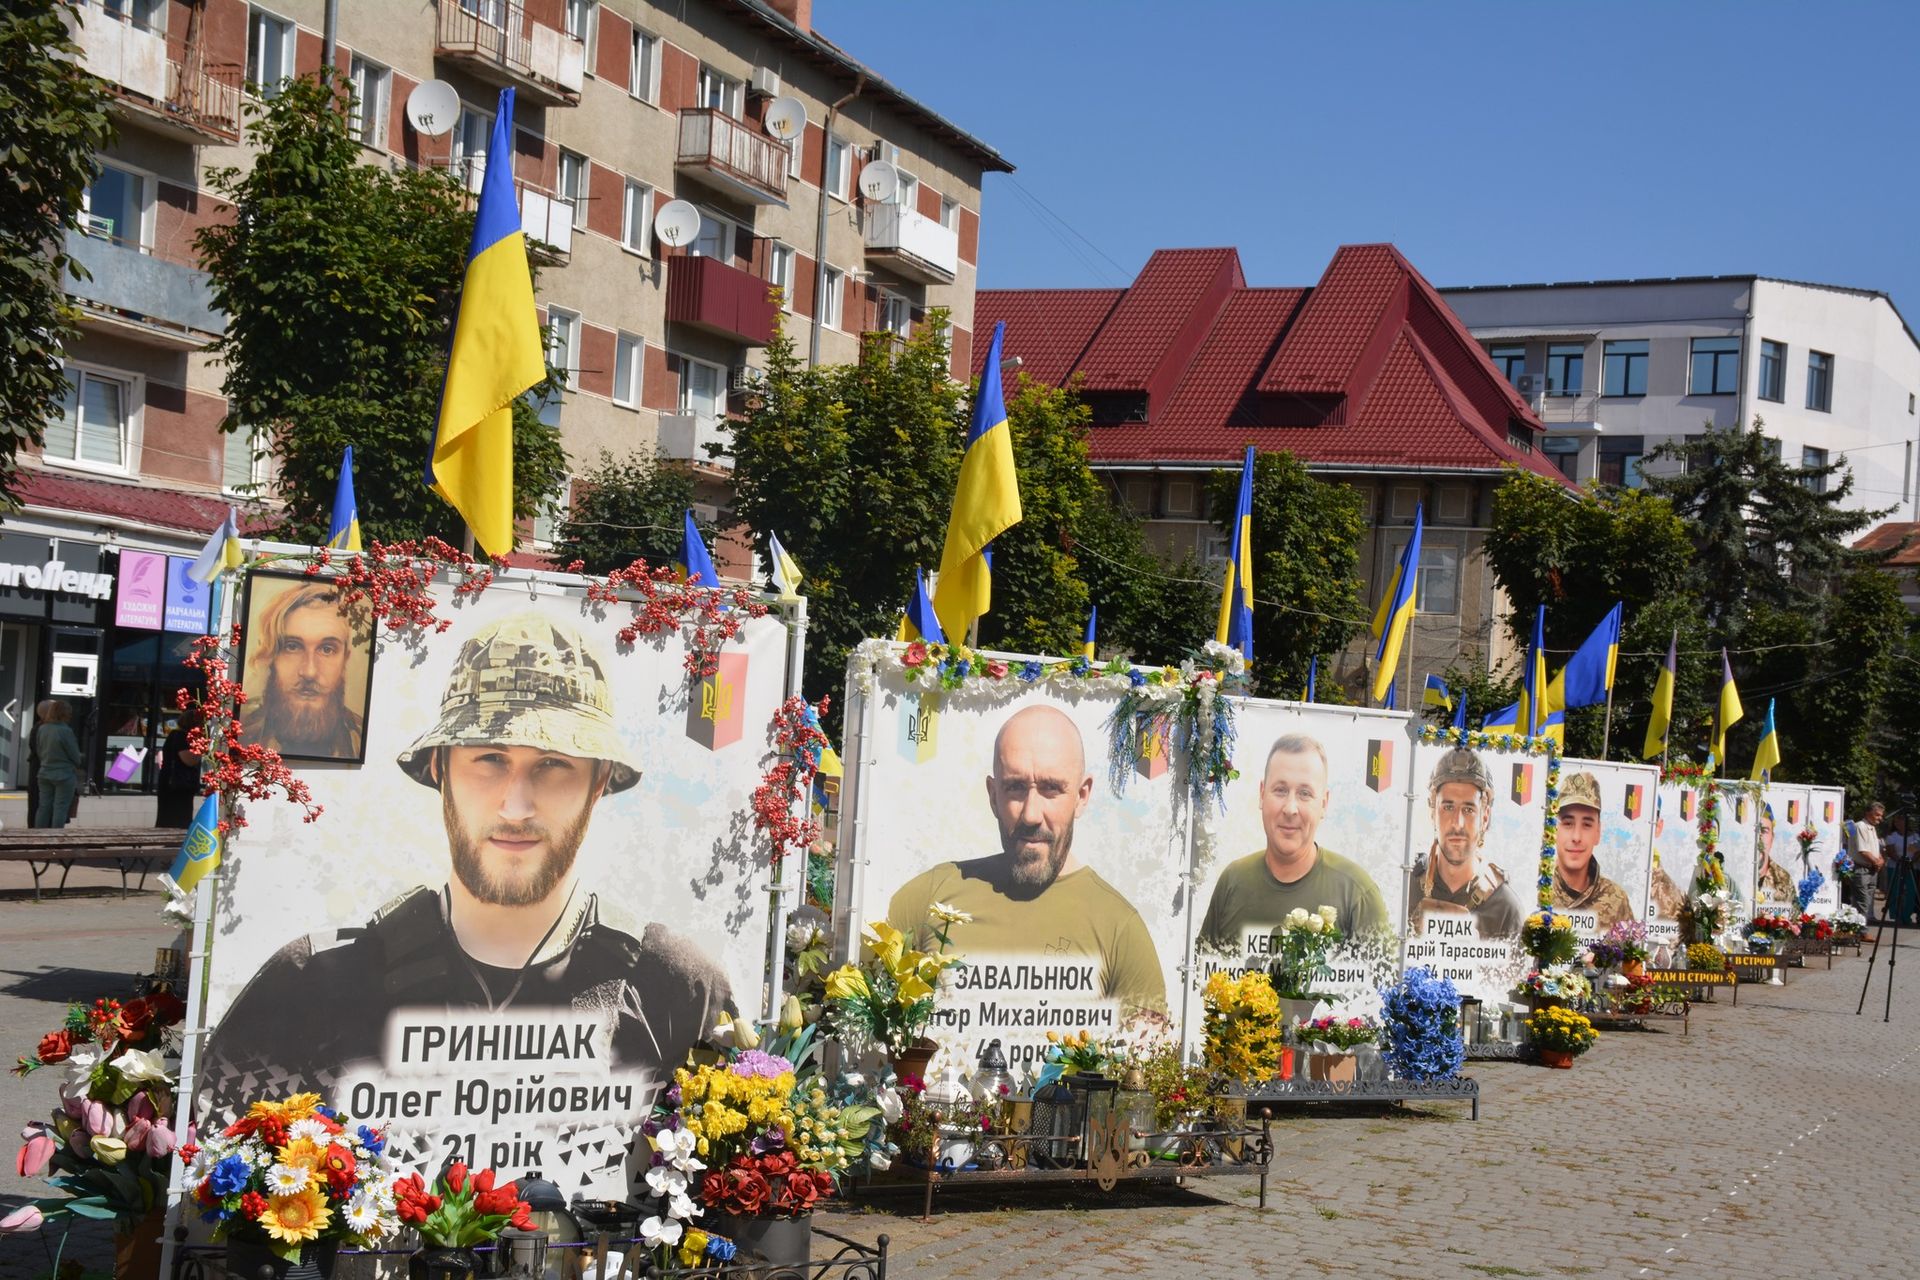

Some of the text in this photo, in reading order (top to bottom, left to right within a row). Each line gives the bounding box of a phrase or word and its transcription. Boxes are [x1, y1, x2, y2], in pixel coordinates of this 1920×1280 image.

[166, 606, 206, 619] НАВЧАЛЬНА
[1427, 919, 1472, 938] РУДАК
[1407, 941, 1506, 961] дрій Тарасович
[1742, 957, 1776, 967] СТРОЮ
[955, 965, 1094, 991] ЗАВАЛЬНЮК
[1443, 968, 1472, 983] роки
[979, 1000, 1112, 1026] Михайлович
[401, 1024, 597, 1063] ГРИНІШАК
[351, 1075, 632, 1125] Олег Юрійович
[441, 1132, 544, 1174] 21 рік
